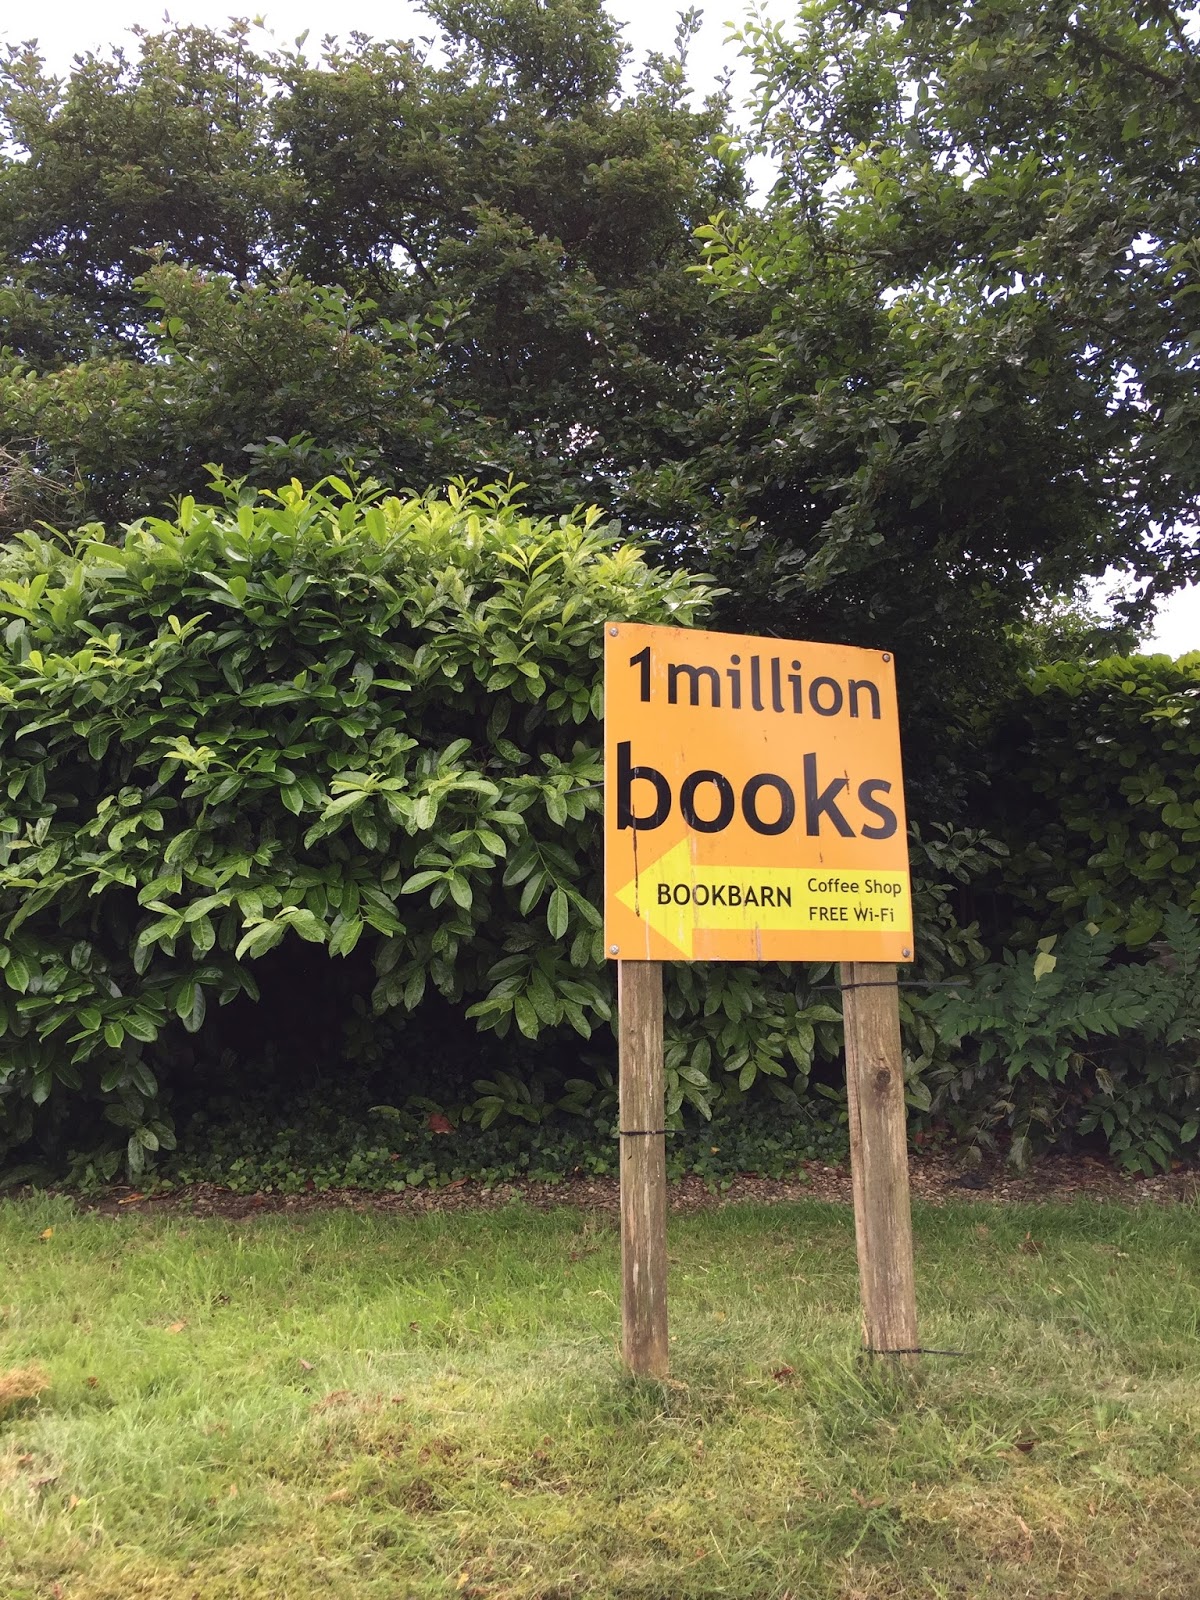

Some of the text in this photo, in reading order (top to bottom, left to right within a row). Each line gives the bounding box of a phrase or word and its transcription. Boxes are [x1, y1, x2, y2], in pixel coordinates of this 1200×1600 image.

[617, 740, 898, 840] books
[657, 883, 792, 908] BOOKBARN
[807, 878, 902, 898] Coffee Shop
[809, 906, 895, 923] FREE Wi-Fi
